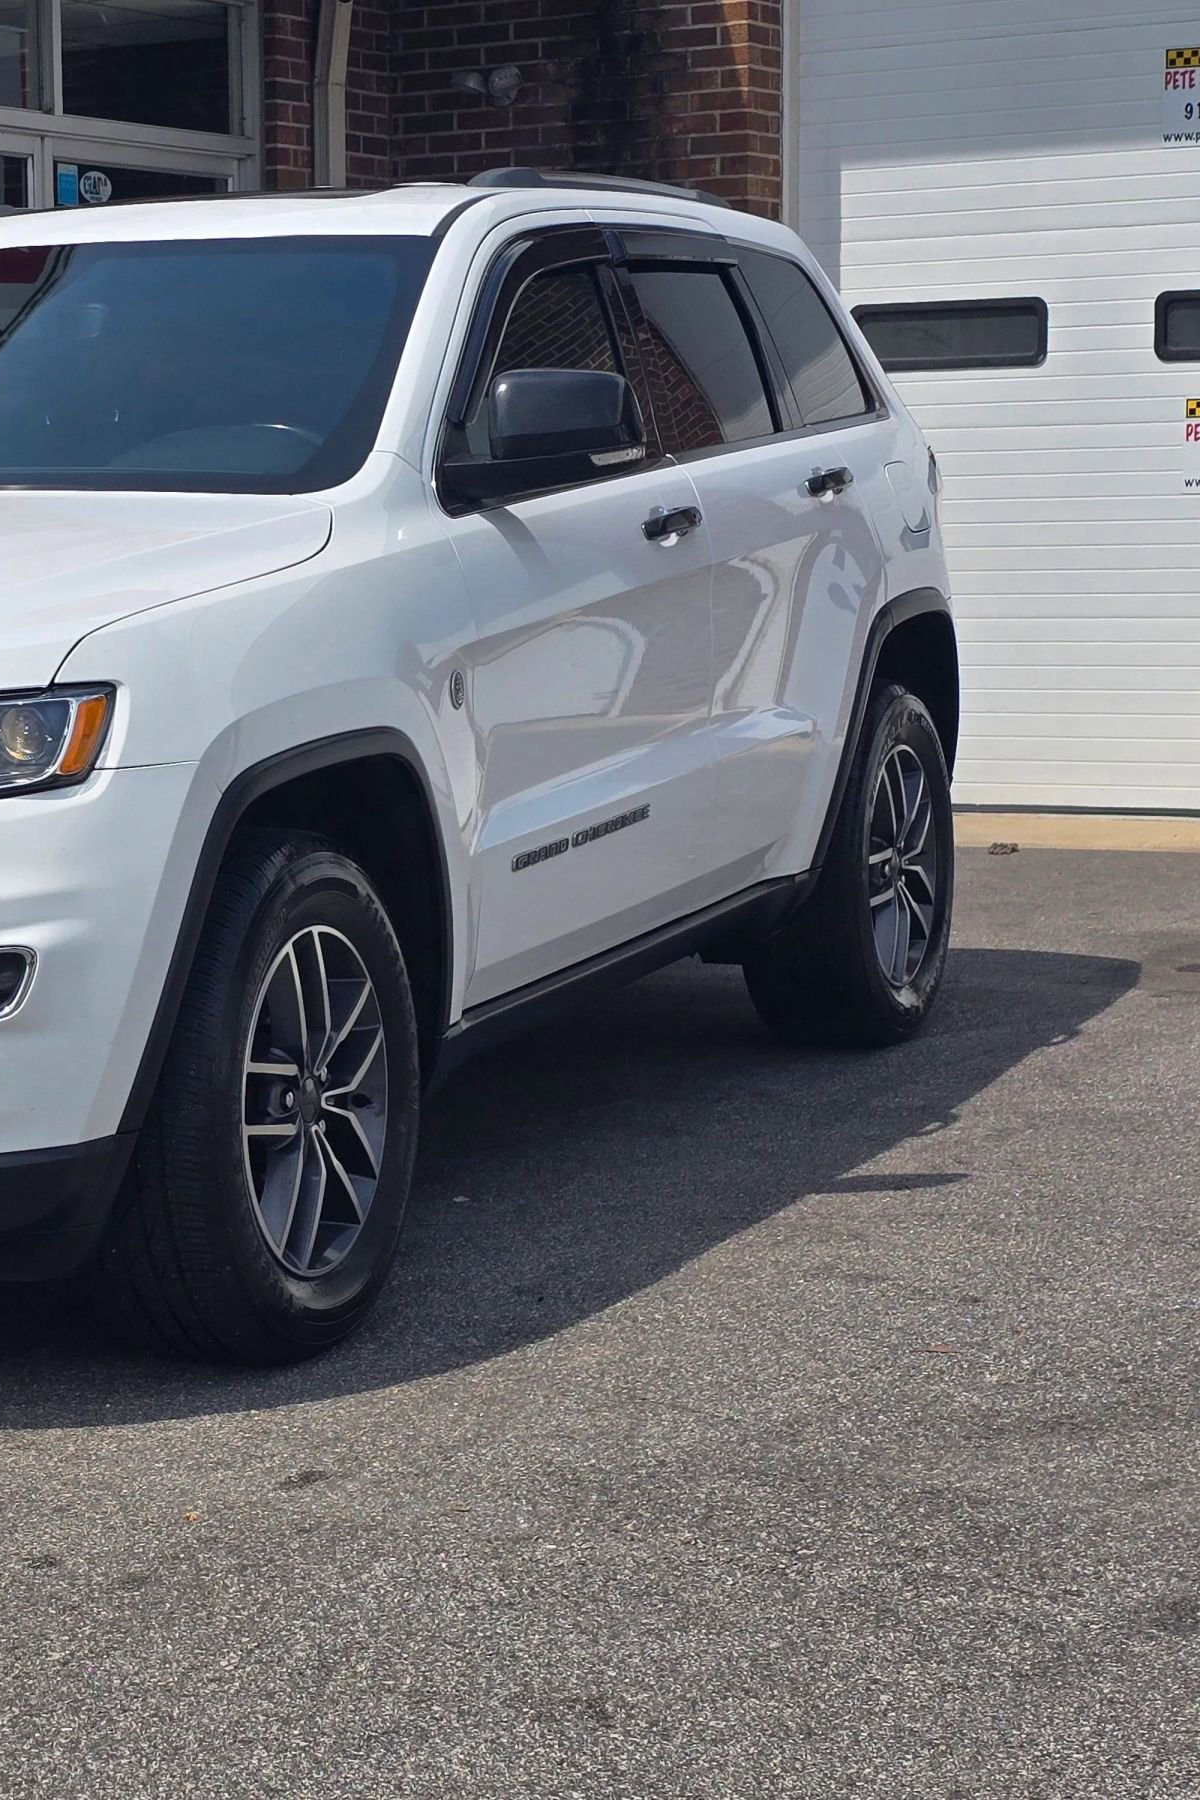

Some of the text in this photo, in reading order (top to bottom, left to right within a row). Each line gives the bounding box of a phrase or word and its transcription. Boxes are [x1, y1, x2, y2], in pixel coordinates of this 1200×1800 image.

[1164, 70, 1196, 91] PETE
[512, 803, 650, 873] GRAND CHEROKEE
